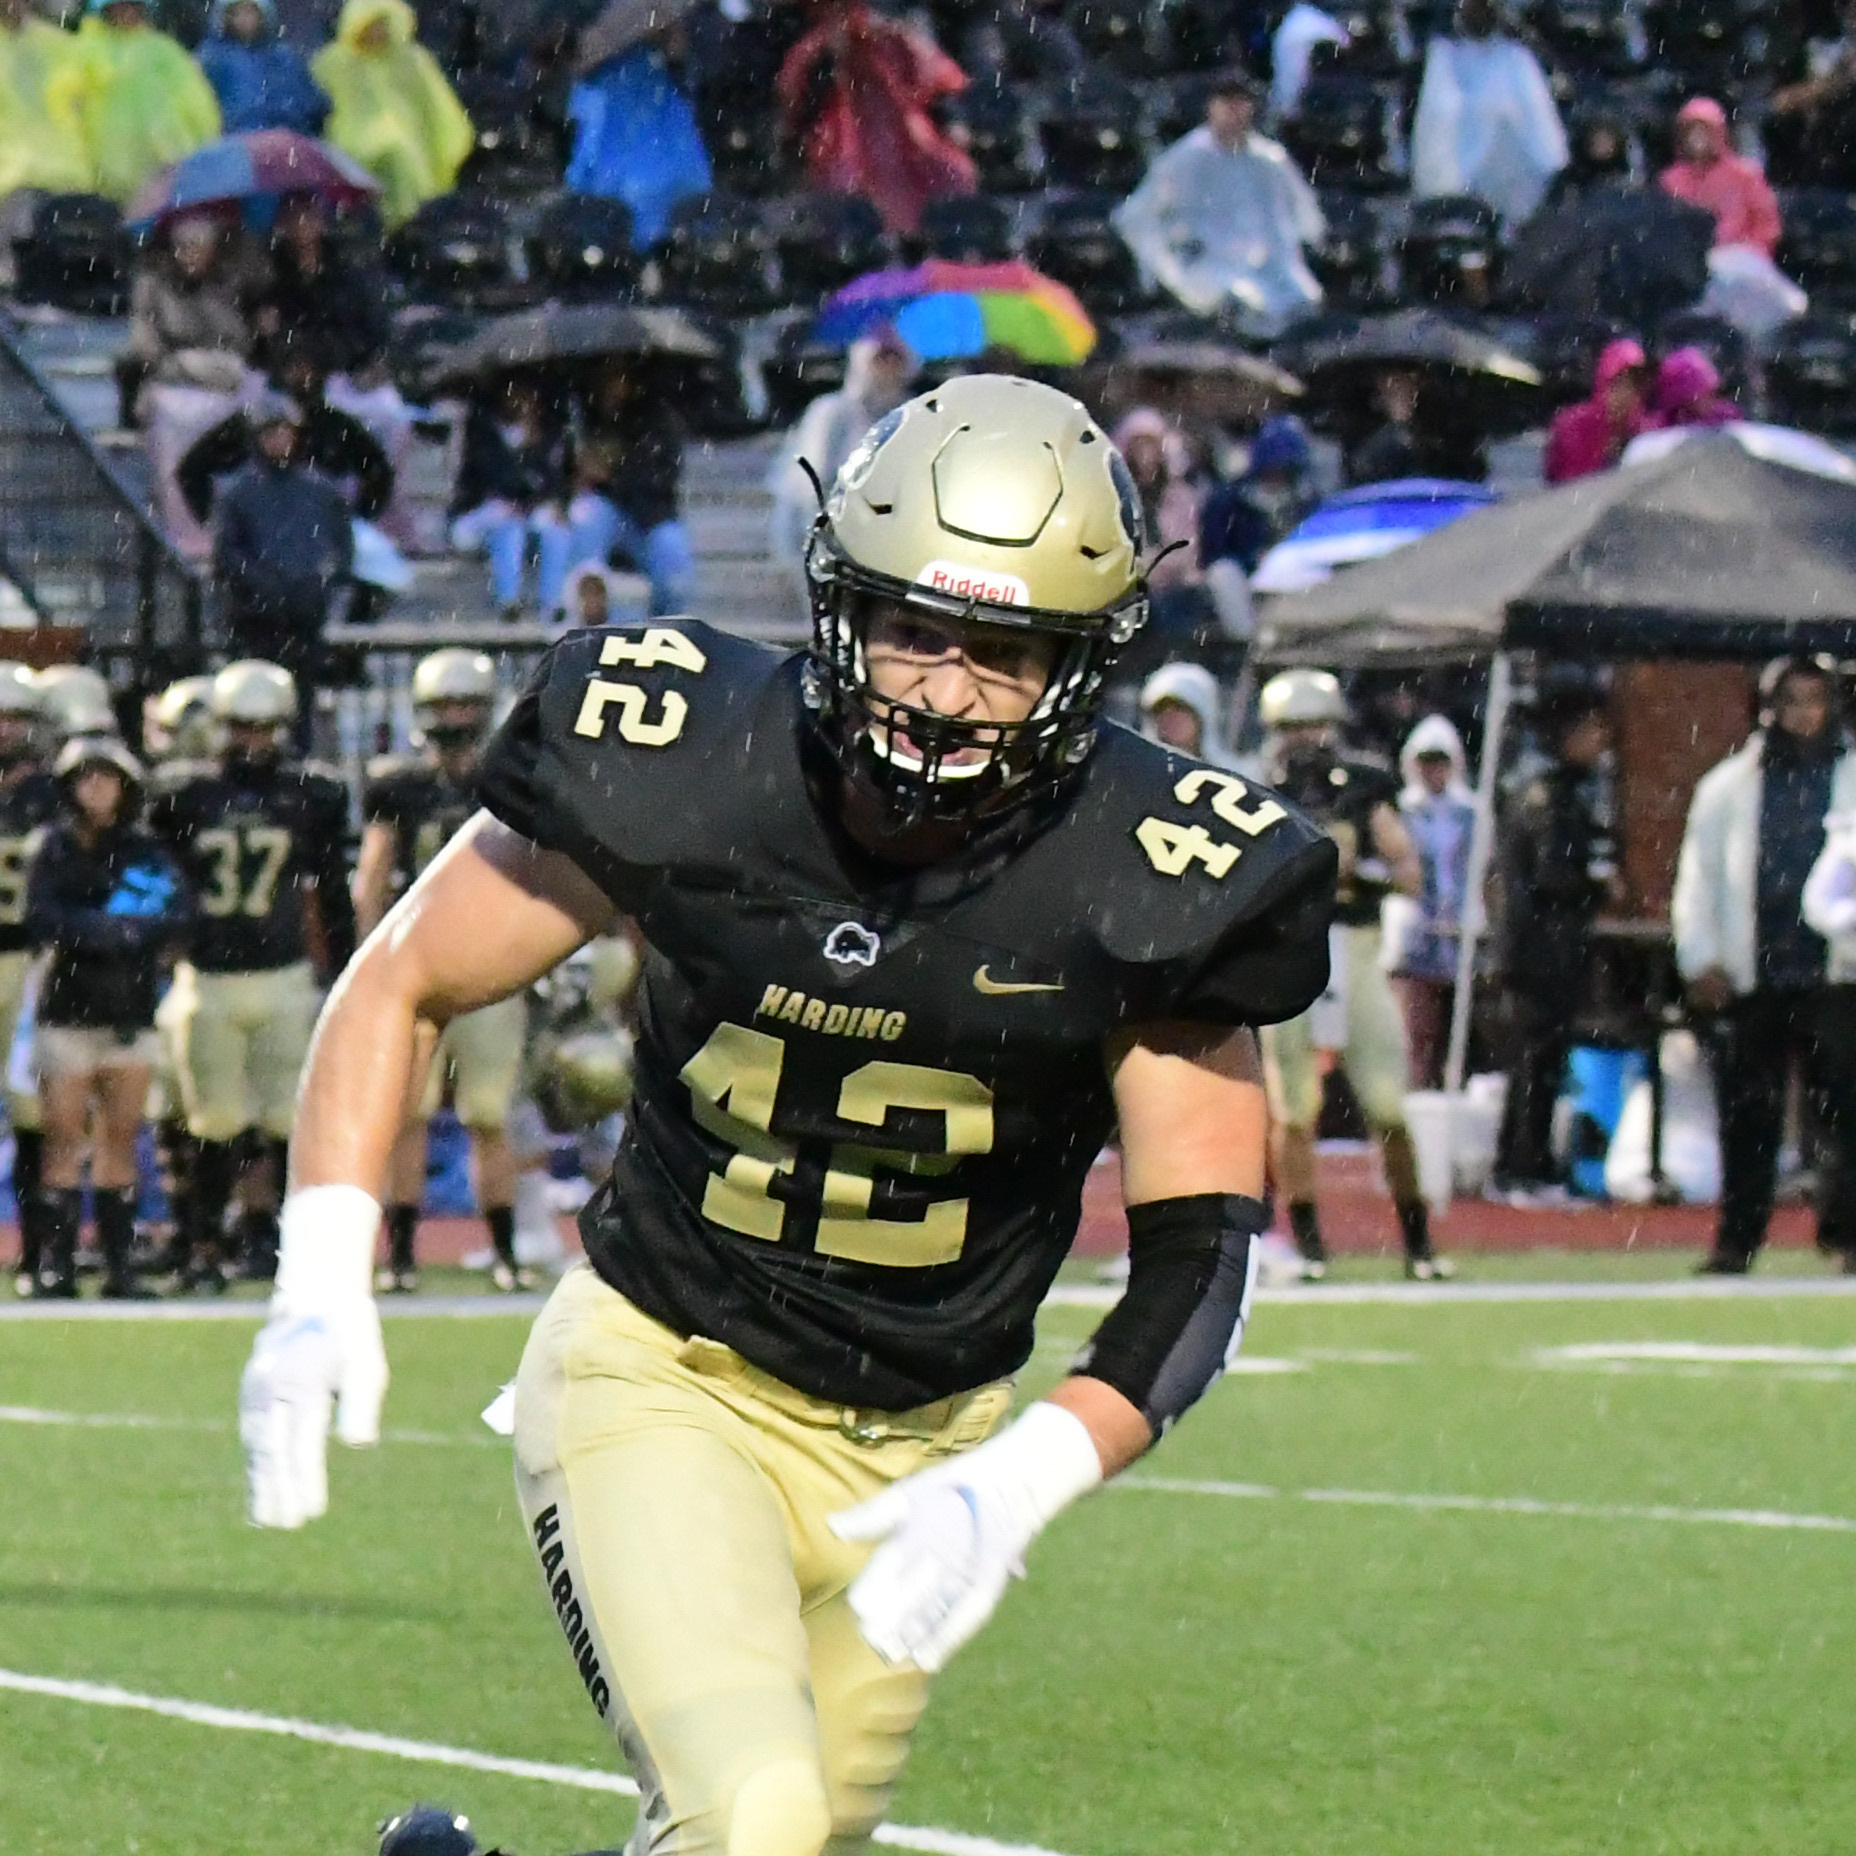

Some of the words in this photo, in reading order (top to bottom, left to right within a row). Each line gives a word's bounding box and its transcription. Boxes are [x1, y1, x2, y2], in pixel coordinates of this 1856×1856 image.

[933, 570, 1016, 605] Riddell
[574, 627, 706, 747] 42
[197, 826, 287, 918] 37
[1135, 769, 1288, 881] 42
[761, 984, 908, 1042] HARDING
[679, 1021, 994, 1267] 42
[534, 1502, 610, 1718] HARDING
